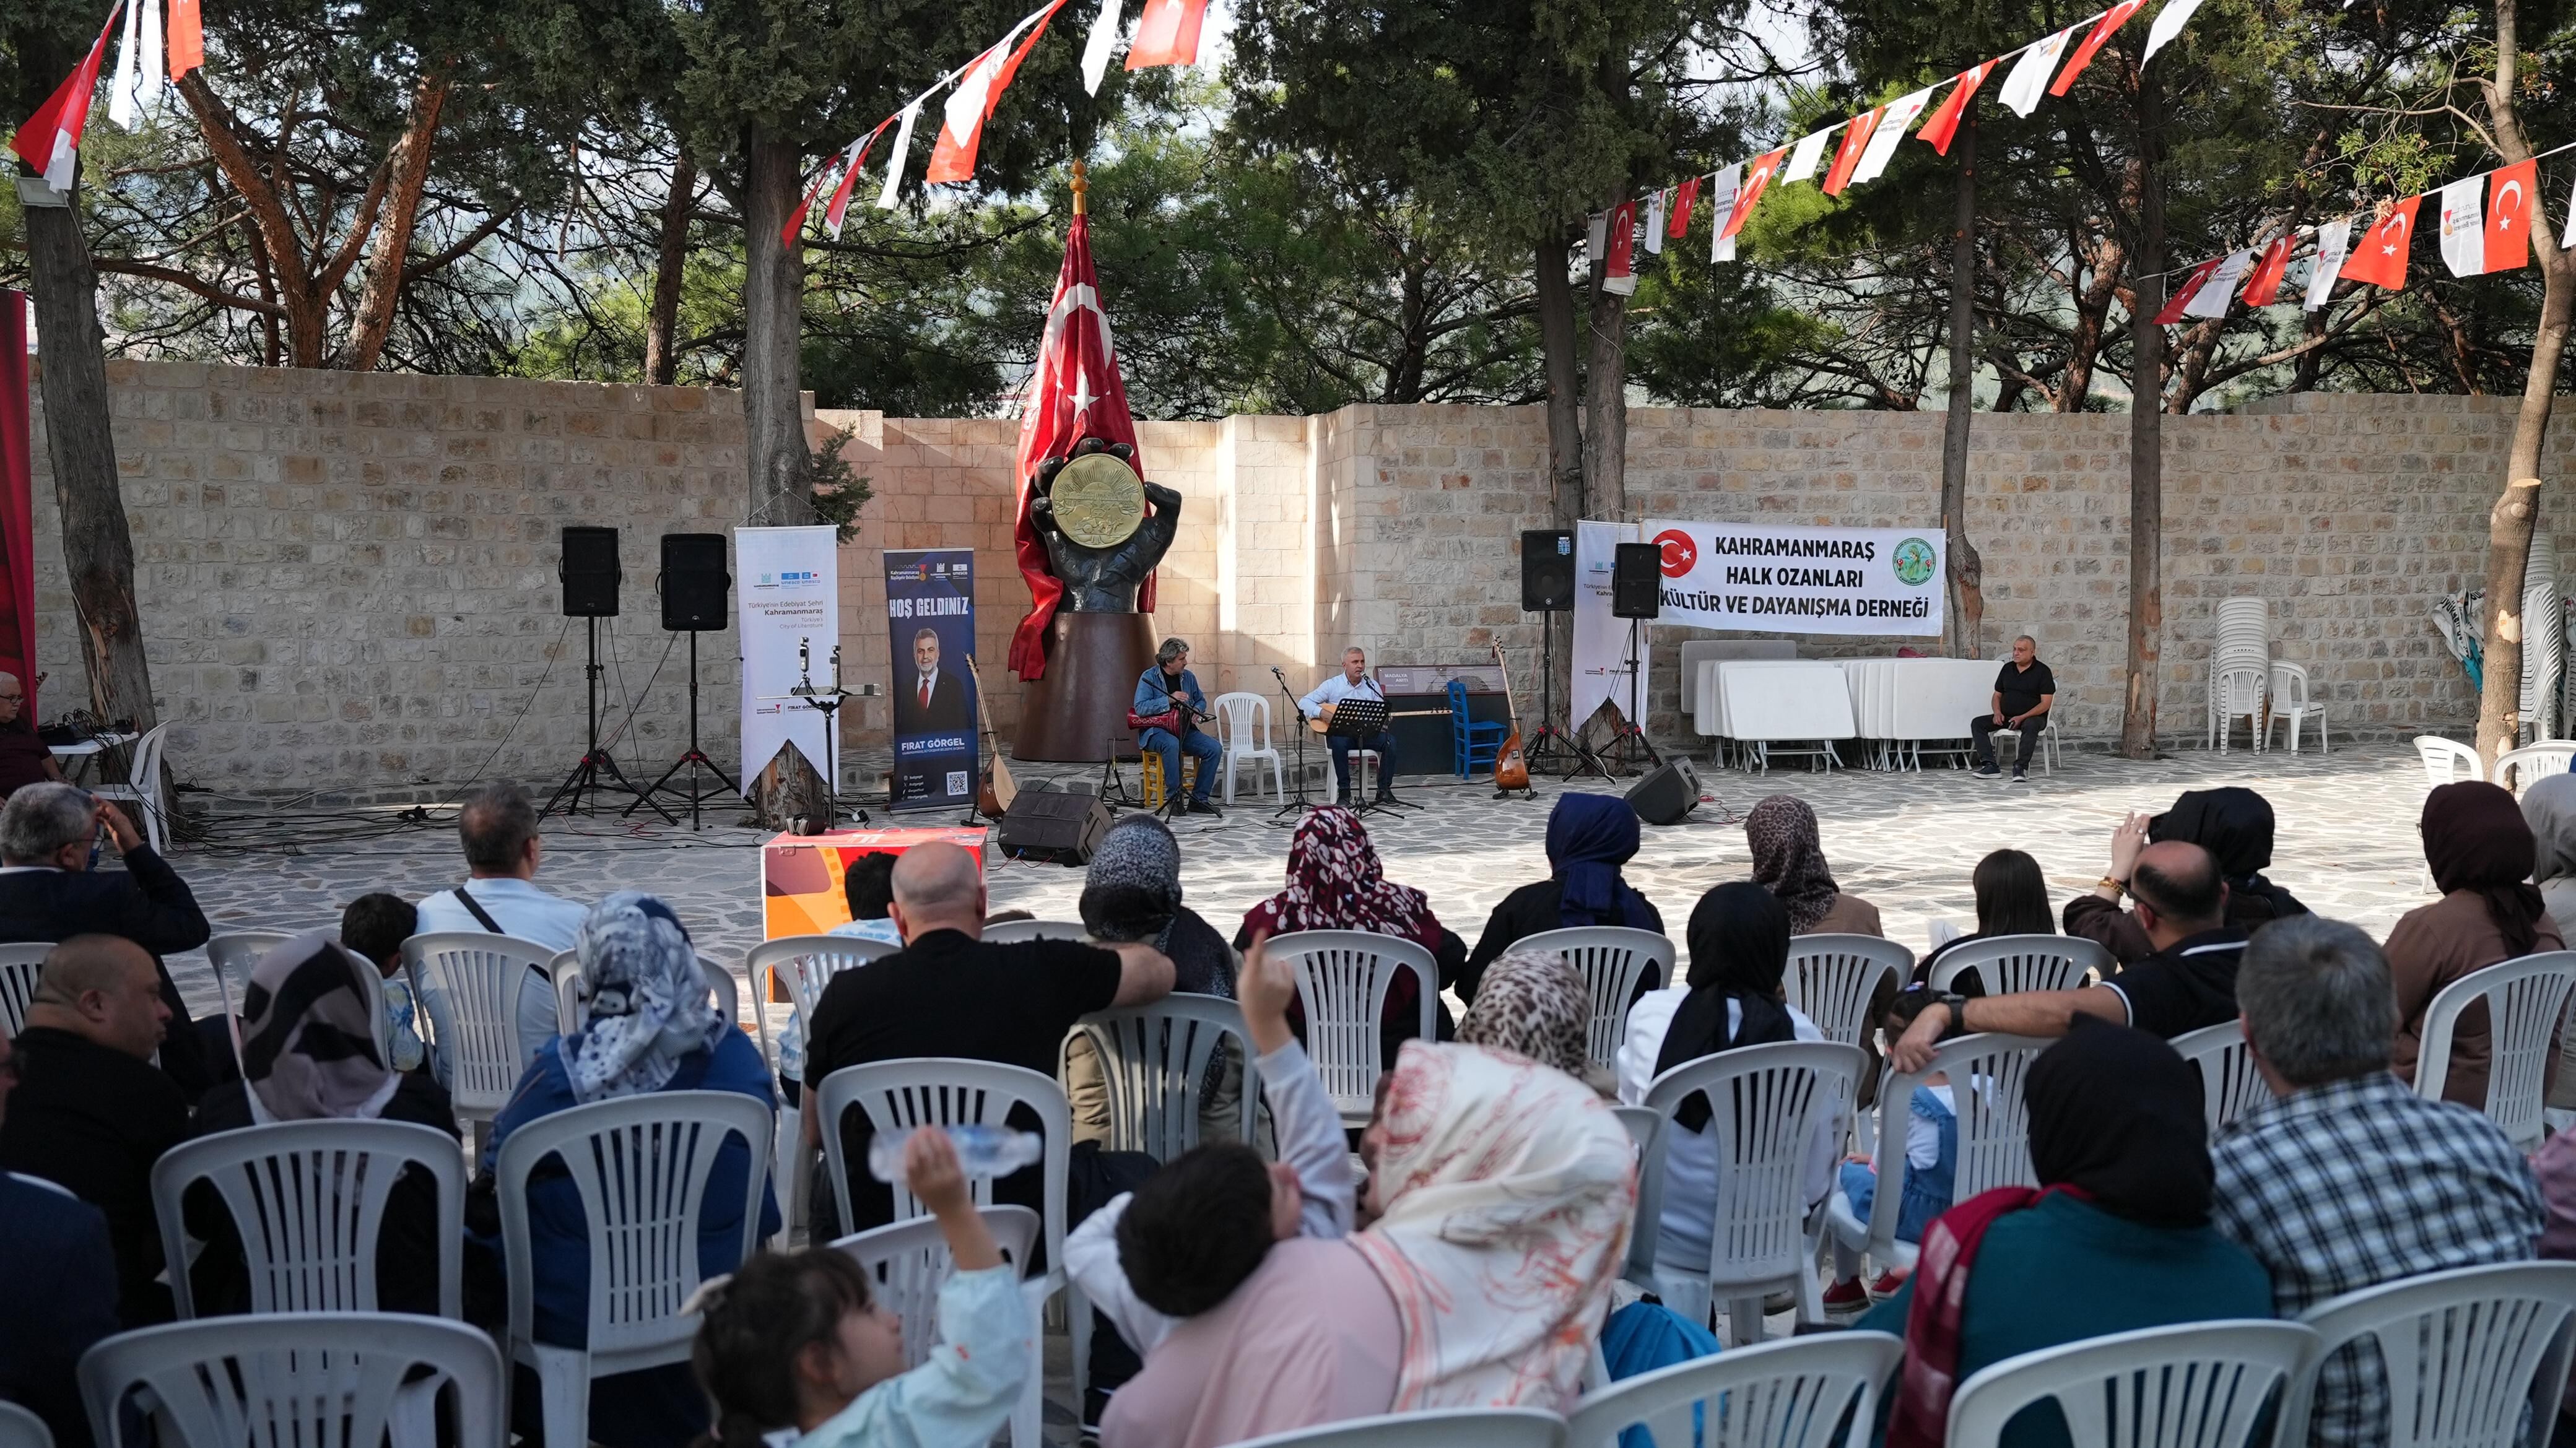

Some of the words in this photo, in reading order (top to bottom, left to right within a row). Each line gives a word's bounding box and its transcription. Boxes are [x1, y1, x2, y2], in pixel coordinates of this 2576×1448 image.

[1715, 536, 1875, 562] KAHRAMANMARAŞ
[1726, 566, 1772, 585] HALK
[1777, 568, 1863, 587] OZANLARI
[889, 598, 913, 619] HOŞ
[1660, 589, 1721, 612] KÜLTÜR
[1726, 596, 1748, 613] VE
[1752, 596, 1852, 618] DAYANIŞMA
[1856, 597, 1929, 618] DERNEĞİ
[902, 740, 926, 751] FIRAT
[927, 737, 965, 748] GÖRGEL
